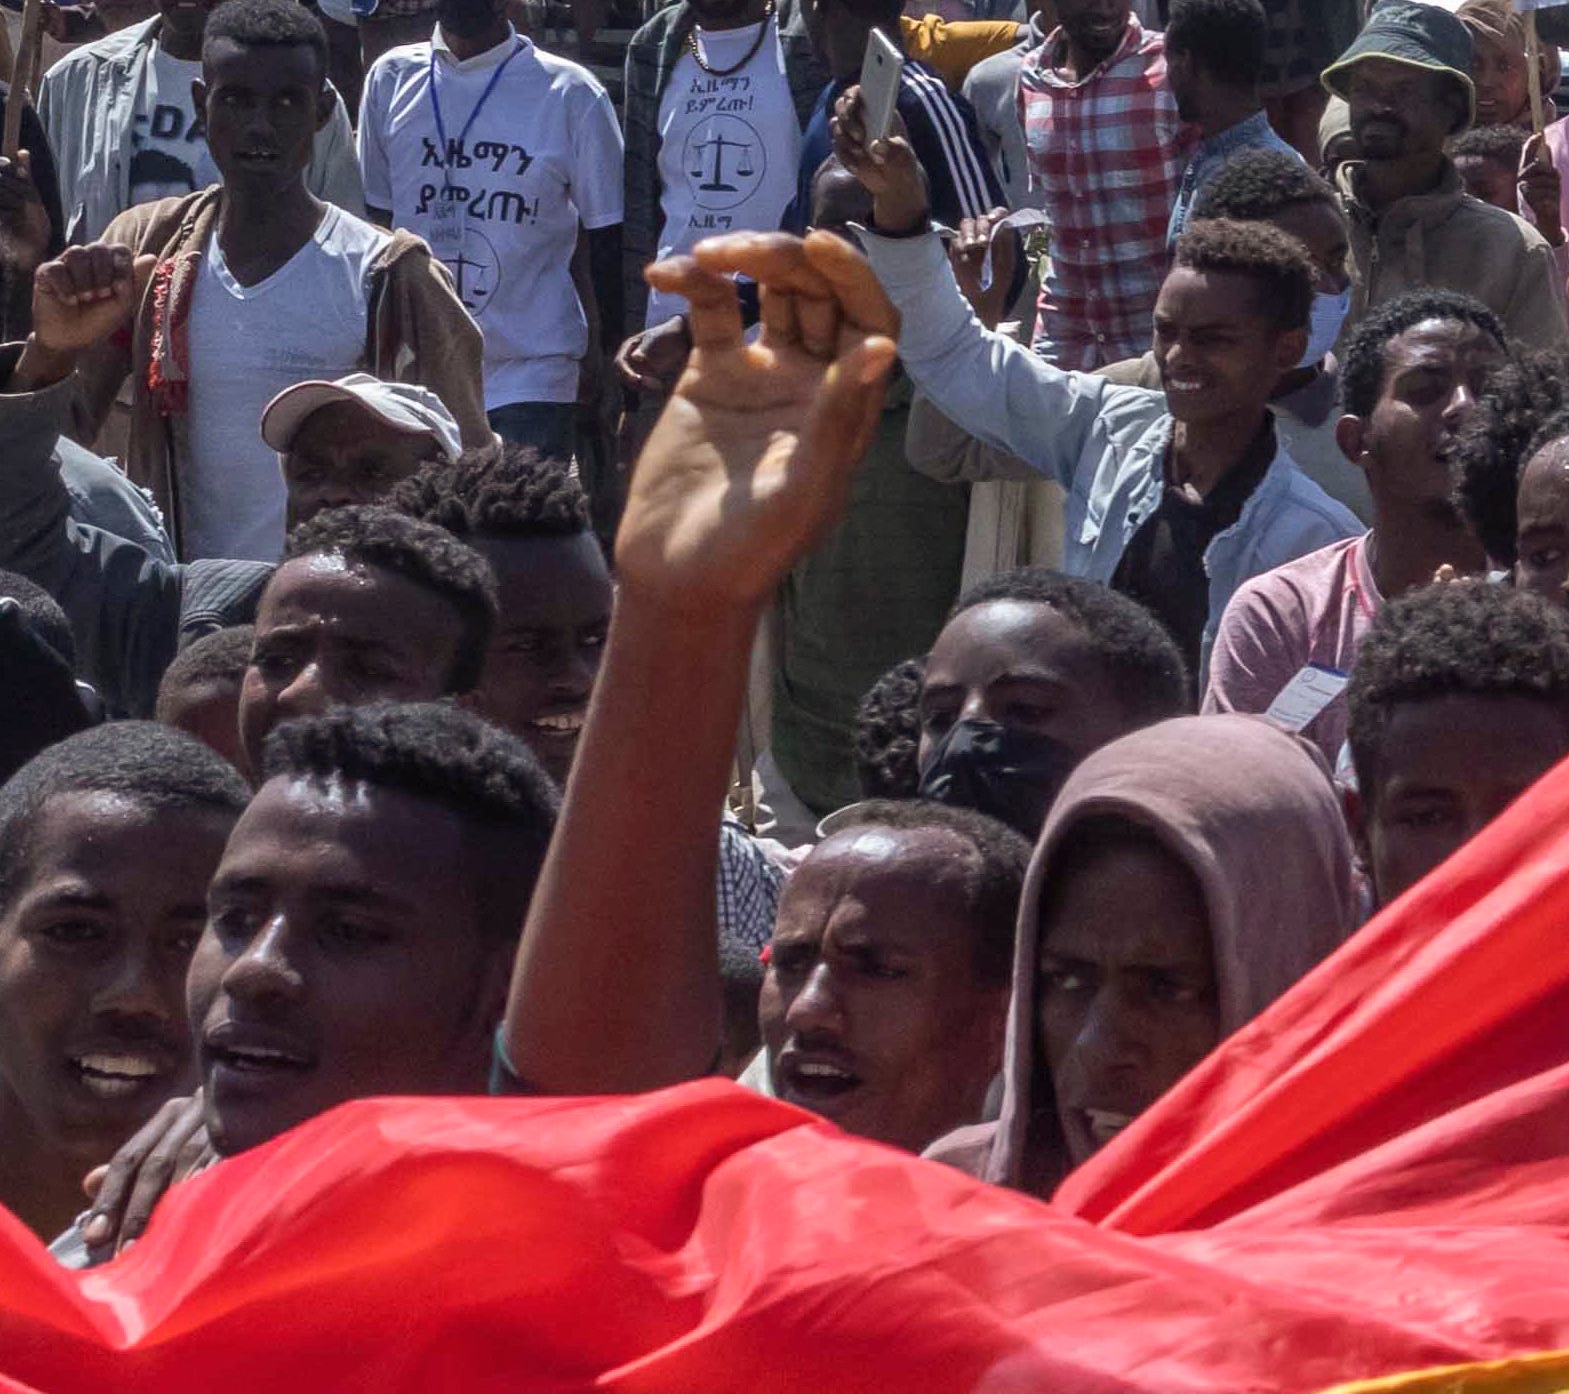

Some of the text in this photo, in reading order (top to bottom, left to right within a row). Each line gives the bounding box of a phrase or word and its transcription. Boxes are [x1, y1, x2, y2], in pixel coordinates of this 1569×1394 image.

[689, 75, 751, 94] ኢዜማን
[685, 95, 754, 115] ይምረጡ!
[421, 137, 534, 176] ኢዜማን
